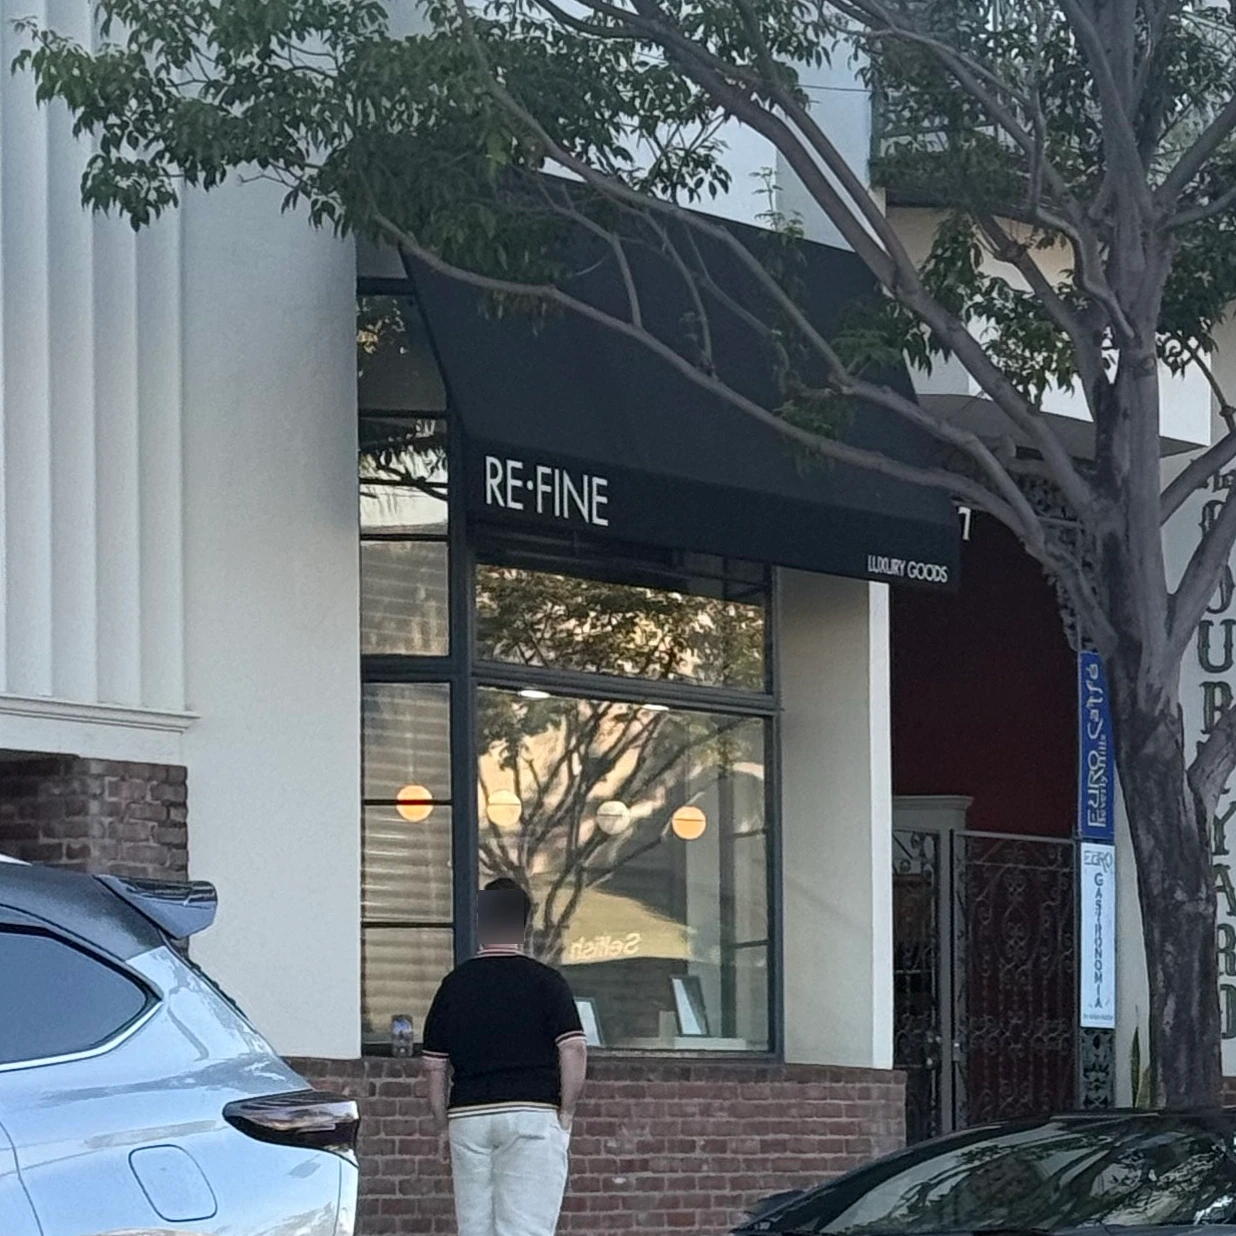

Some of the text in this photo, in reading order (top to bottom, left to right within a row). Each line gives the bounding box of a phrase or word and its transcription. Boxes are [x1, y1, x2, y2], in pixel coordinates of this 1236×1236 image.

[867, 555, 948, 583] LUXURY GOODS
[1094, 873, 1104, 1008] GASTRONOMIA
